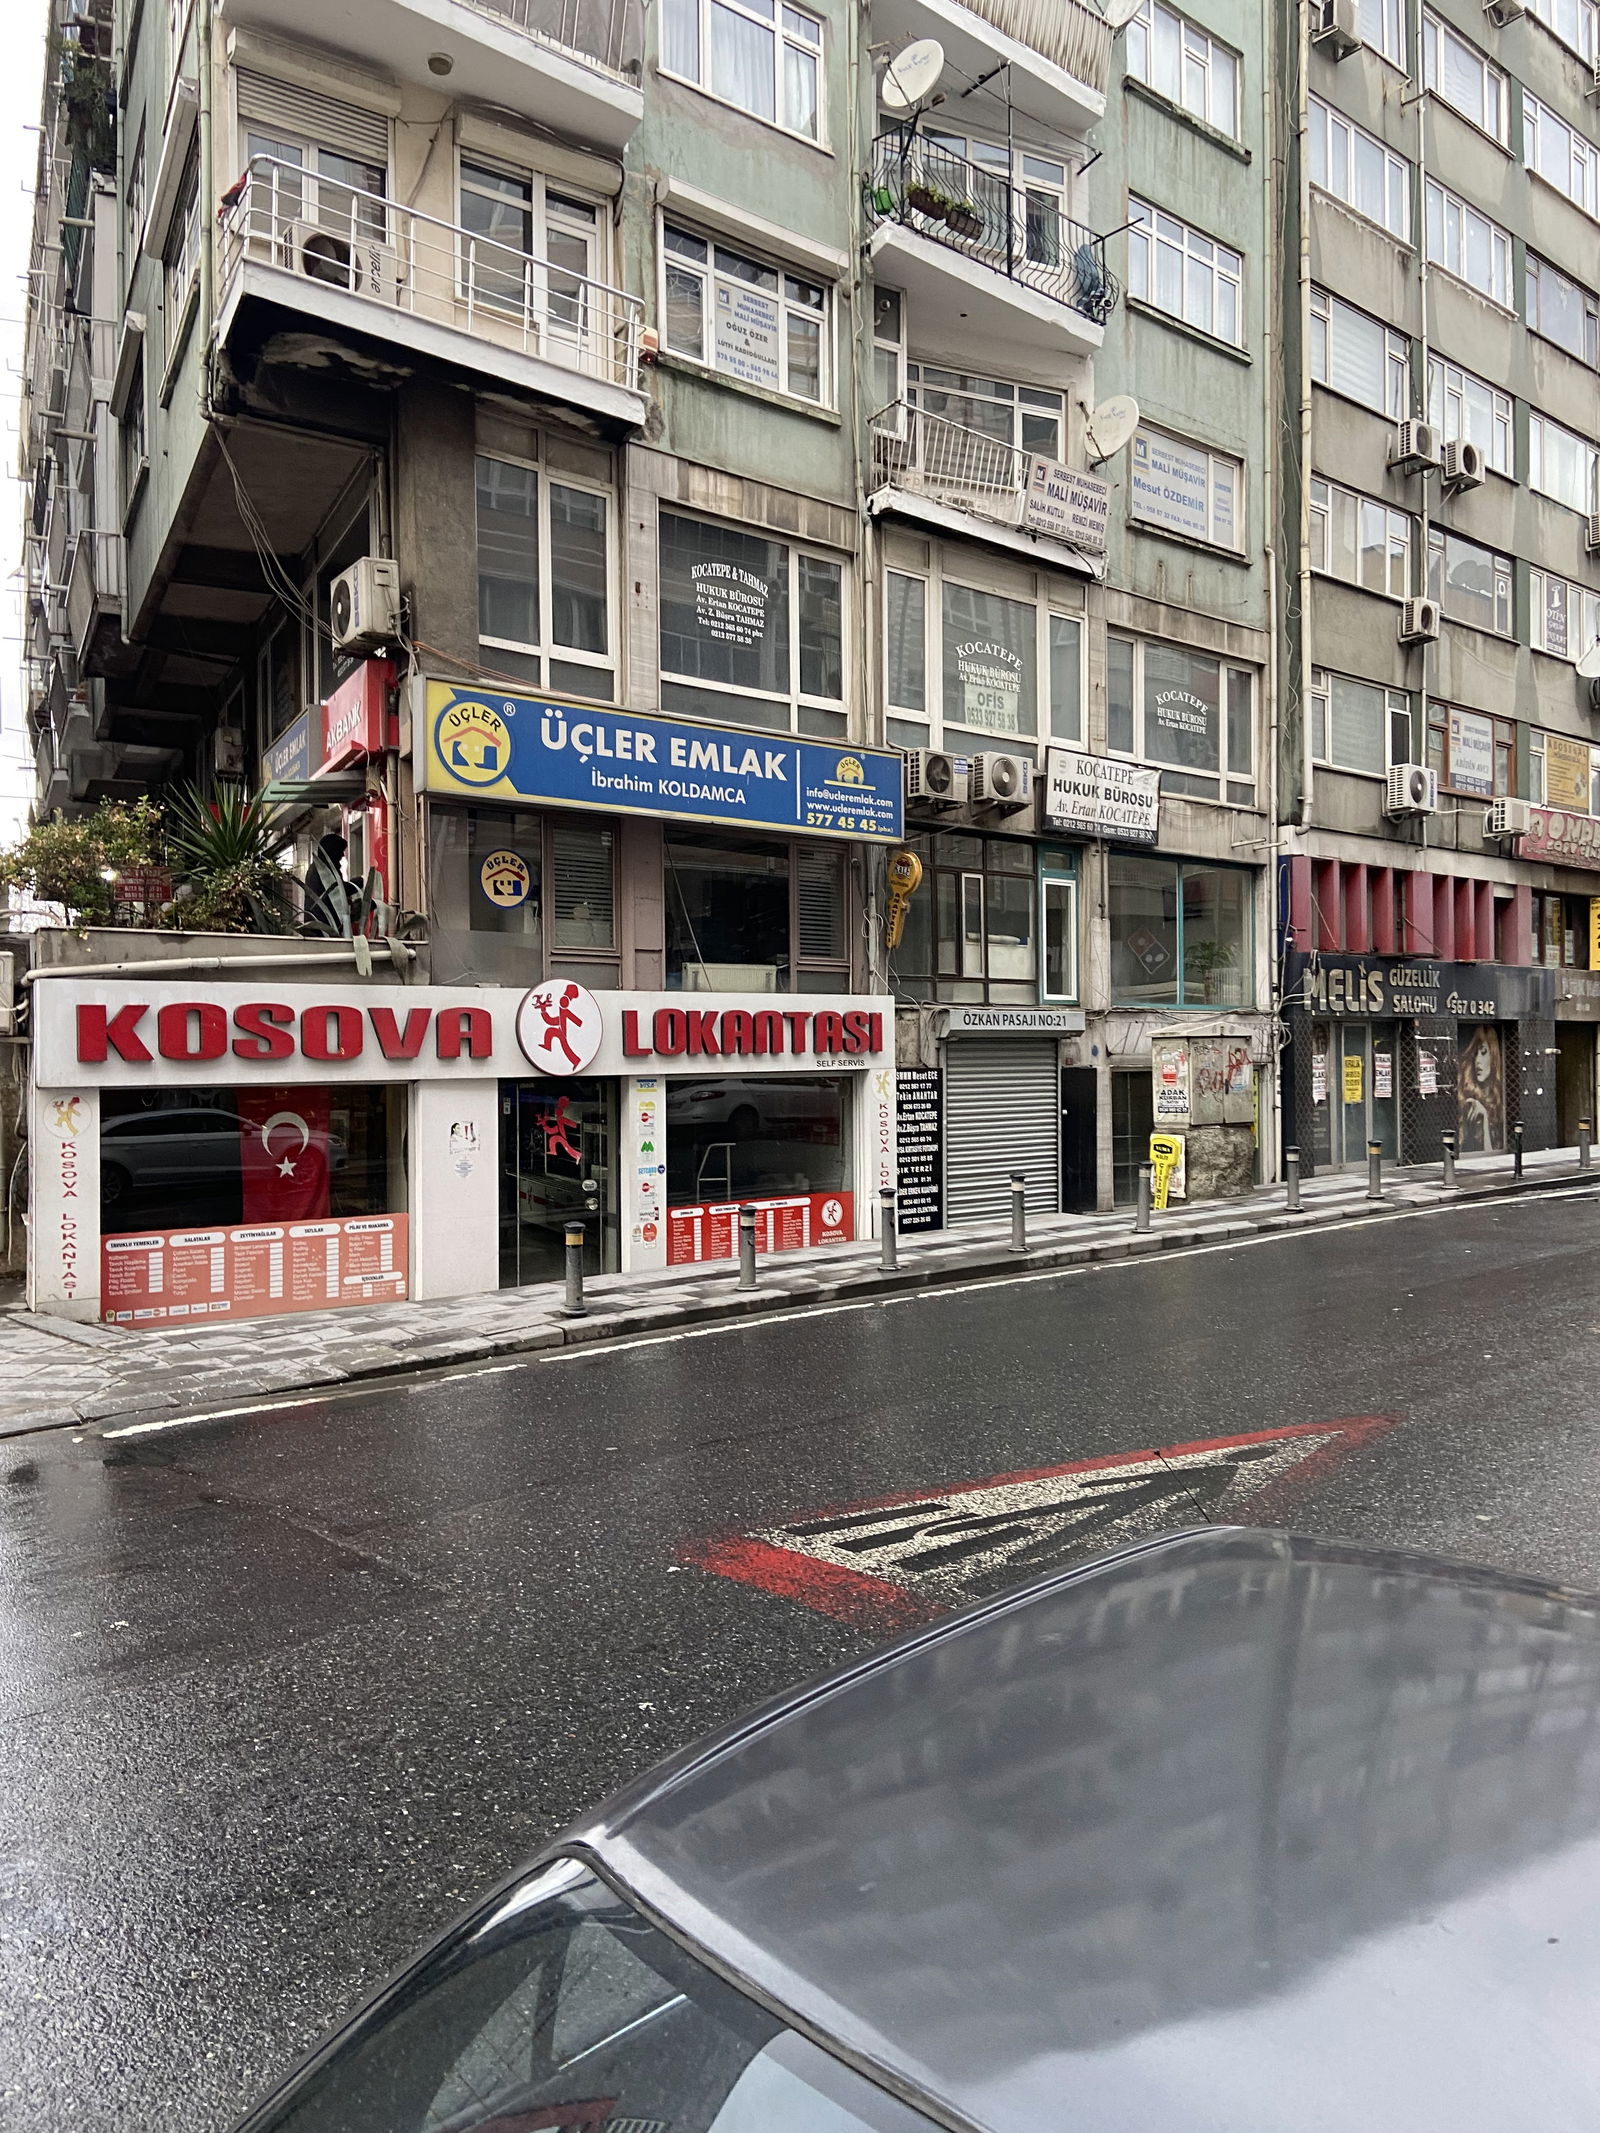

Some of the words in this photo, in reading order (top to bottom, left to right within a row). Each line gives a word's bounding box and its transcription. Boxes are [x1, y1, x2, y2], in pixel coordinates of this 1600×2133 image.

[726, 321, 748, 336] OĞUZ
[749, 328, 768, 343] ÖZER
[1151, 460, 1170, 474] MALİ
[1172, 467, 1205, 488] MÜŞAVİR
[1047, 482, 1069, 503] MALİ
[1070, 490, 1108, 516] MÜŞAVİR
[1133, 476, 1161, 496] Mesut
[1163, 486, 1205, 512] ÖZDEMİR
[1046, 503, 1065, 519] KUTLU
[691, 563, 731, 579] KOCATEPE
[732, 566, 738, 580] &
[738, 568, 769, 598] TAHMAZ
[695, 582, 728, 598] HUKUK
[729, 590, 764, 607] BÜROSU
[696, 595, 707, 605] Av.
[728, 602, 765, 618] KOCATEPE
[696, 605, 707, 615] Av.
[708, 608, 715, 616] Z.
[735, 614, 764, 628] TAHMAZ
[710, 620, 724, 629] 0212
[711, 629, 725, 638] 0212
[955, 641, 1023, 671] KOCATEPE
[958, 660, 989, 676] HUKUK
[989, 666, 1021, 683] BÜROSU
[986, 678, 1021, 692] KOCATEPE
[977, 691, 1004, 710] OFİS
[1155, 690, 1208, 716] KOCATEPE
[326, 700, 362, 752] AKBANK
[449, 706, 502, 733] ÜÇLER
[1157, 707, 1181, 720] HUKUK
[1181, 711, 1207, 726] BÜROSU
[540, 708, 658, 764] ÜÇLER
[669, 737, 788, 782] EMLAK
[840, 756, 861, 770] ÜÇLER
[1076, 759, 1134, 786] KOCATEPE
[591, 766, 653, 793] İbrahim
[658, 780, 747, 804] KOLDAMCA
[1053, 778, 1100, 799] HUKUK
[1104, 786, 1153, 808] BÜROSU
[806, 787, 893, 808] info@ucleremlak.com
[806, 801, 893, 820] www.ucleremlak.com
[807, 812, 833, 826] 577
[837, 816, 855, 829] 45
[859, 819, 876, 831] 45
[1055, 799, 1068, 813] Av.
[1071, 800, 1097, 818] Ertan
[1098, 804, 1151, 826] KOCATEPE
[486, 855, 525, 872] ÜÇLER
[1389, 964, 1440, 988] GÜZELLİK
[1393, 994, 1438, 1014] SALONU
[1451, 1001, 1468, 1014] 567
[1477, 1001, 1495, 1015] 342
[963, 1011, 1000, 1026] ÖZKAN
[1002, 1014, 1036, 1027] PASAJI
[1038, 1014, 1067, 1026] NO:21
[76, 1002, 494, 1063] KOSOVA
[622, 1008, 884, 1057] LOKANTASI
[816, 1059, 836, 1068] SELF
[837, 1058, 866, 1068] SERVİS
[927, 1070, 938, 1080] ECE
[878, 1103, 890, 1153] KOSOVA
[60, 1141, 78, 1198] KOSOVA
[910, 1164, 932, 1173] TERZİ
[60, 1213, 78, 1299] LOKANTASI
